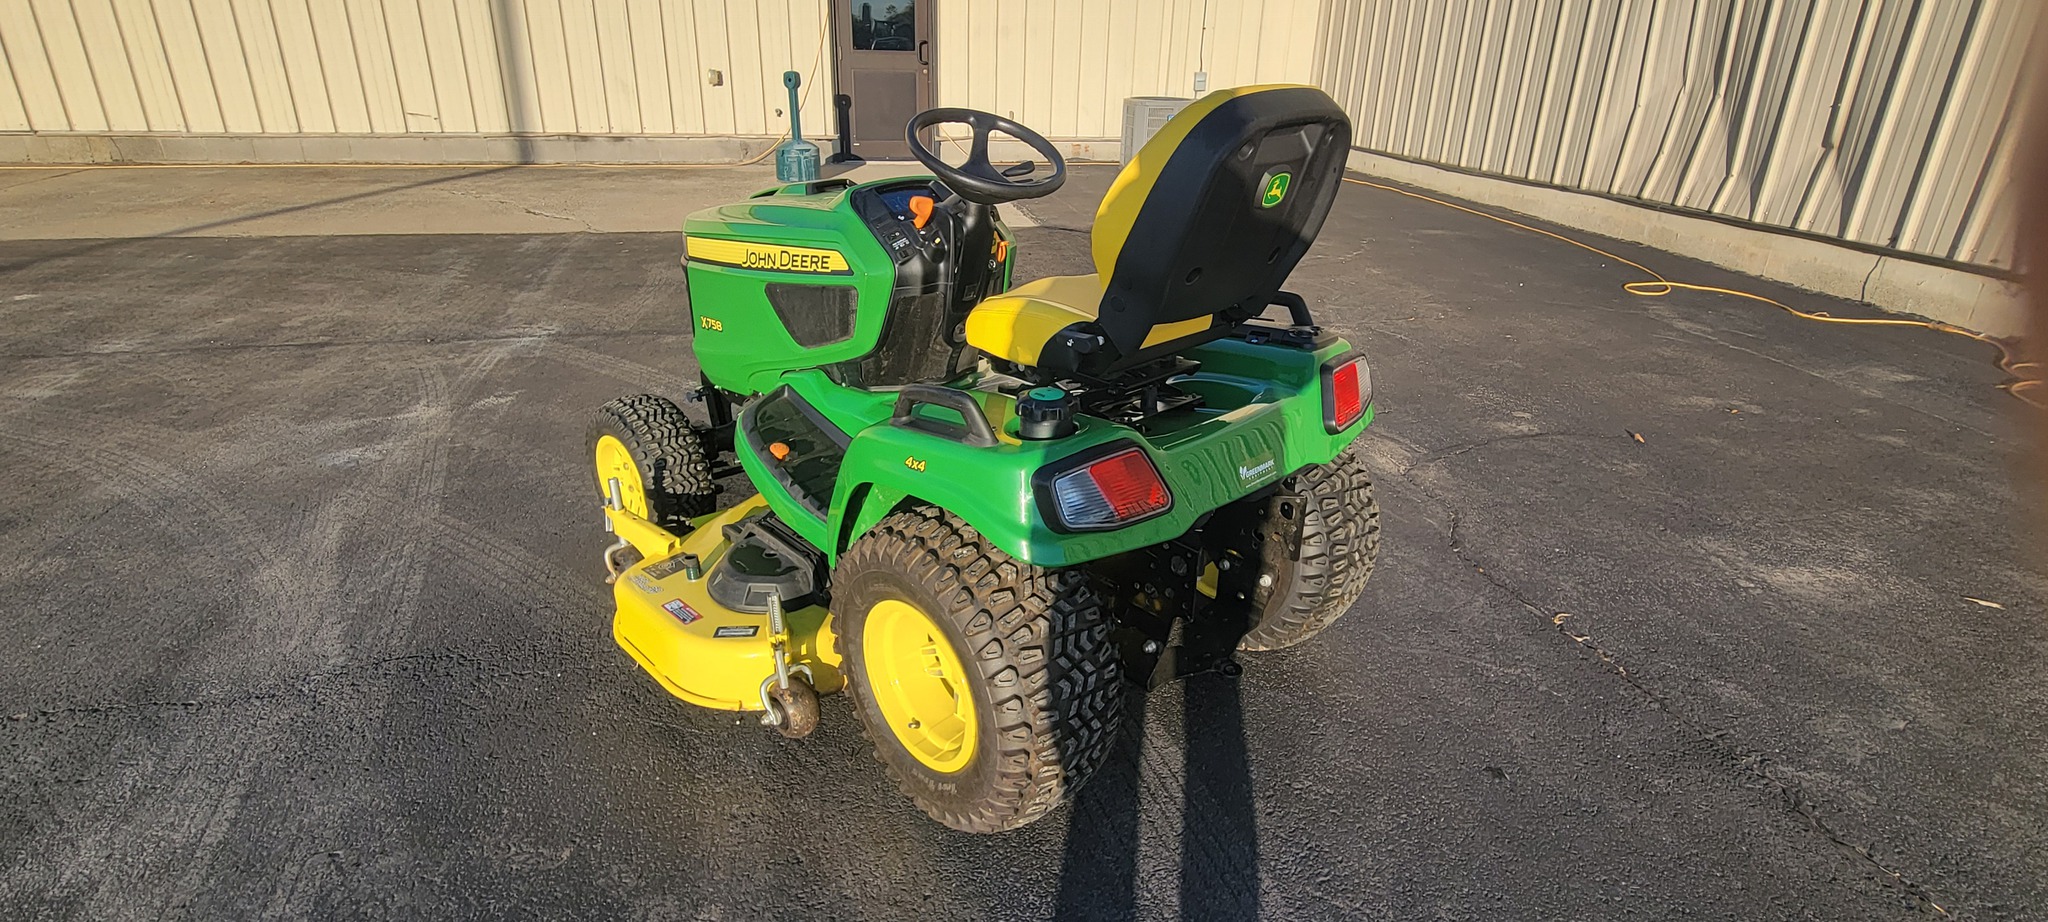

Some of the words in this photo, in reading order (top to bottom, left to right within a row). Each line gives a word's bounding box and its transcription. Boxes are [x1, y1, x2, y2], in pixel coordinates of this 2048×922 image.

[742, 248, 776, 267] JOHN
[780, 250, 830, 269] DEERE
[700, 315, 723, 332] X758
[904, 456, 926, 472] 4x4
